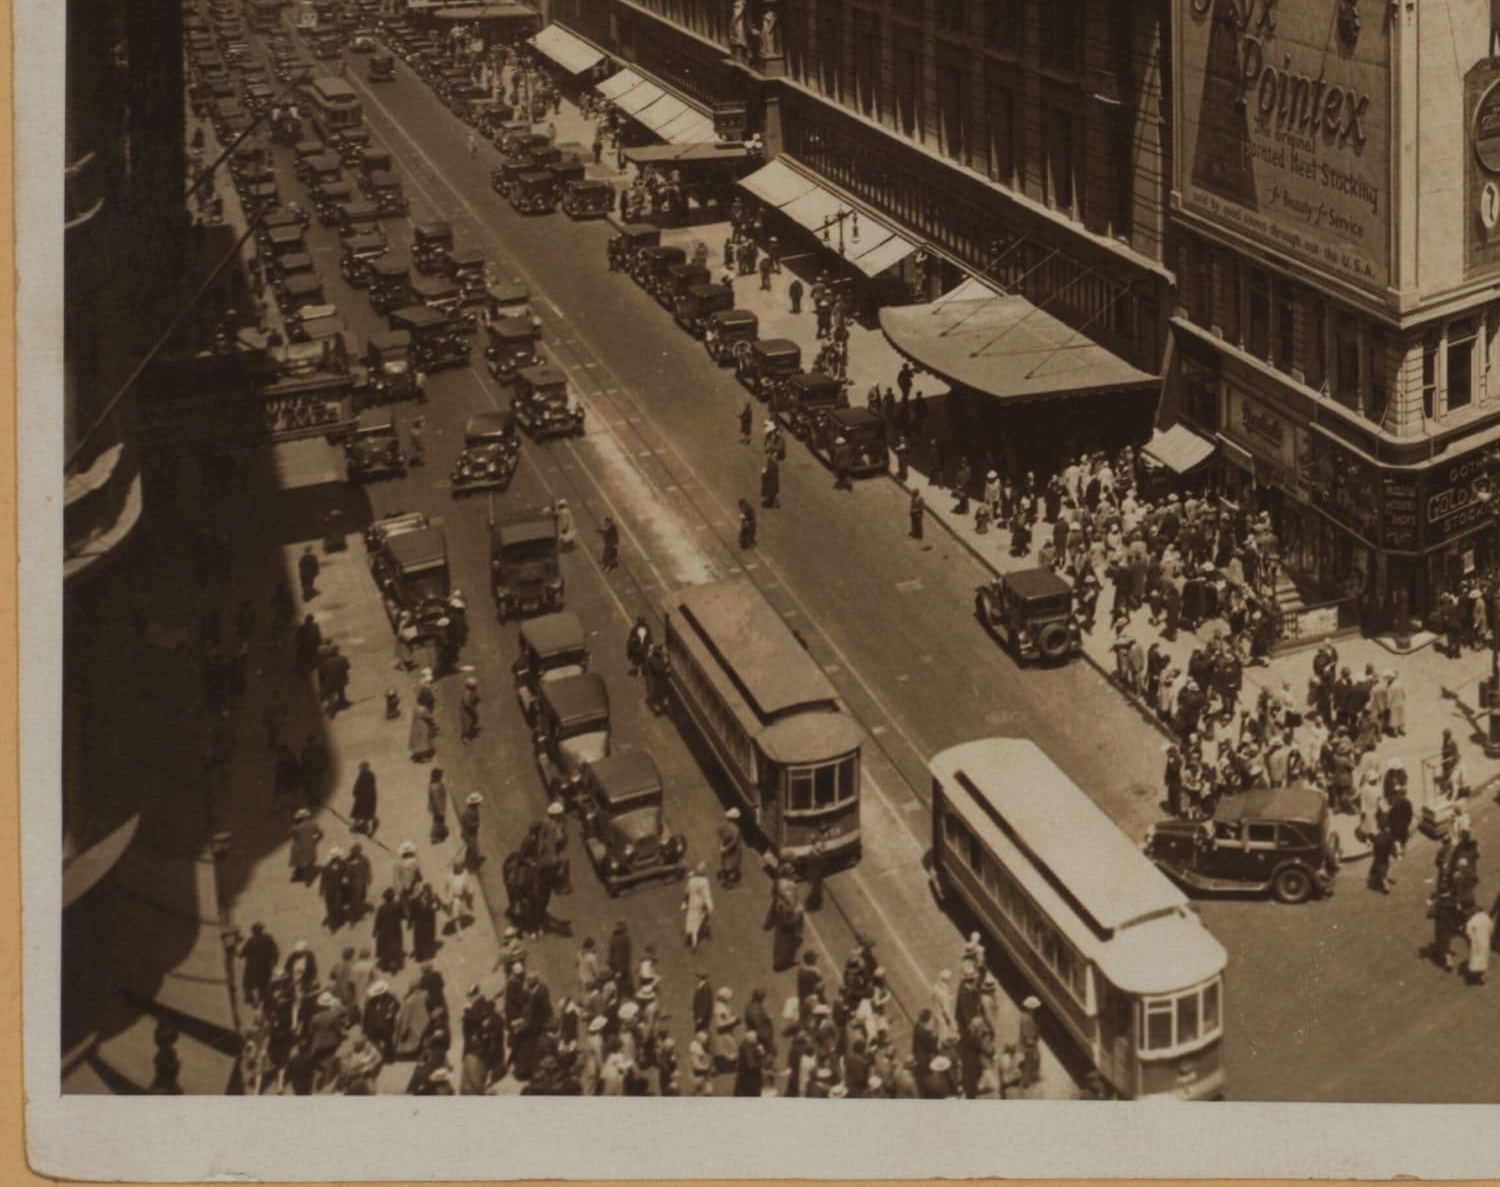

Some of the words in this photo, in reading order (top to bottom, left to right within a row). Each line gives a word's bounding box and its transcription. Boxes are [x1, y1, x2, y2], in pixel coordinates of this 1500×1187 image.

[1235, 34, 1369, 147] Pointex
[1289, 148, 1317, 182] Heel
[1320, 162, 1379, 215] Stocking
[1328, 208, 1364, 238] Service
[1341, 254, 1377, 281] U.S.A.
[1427, 488, 1469, 524] GOLD
